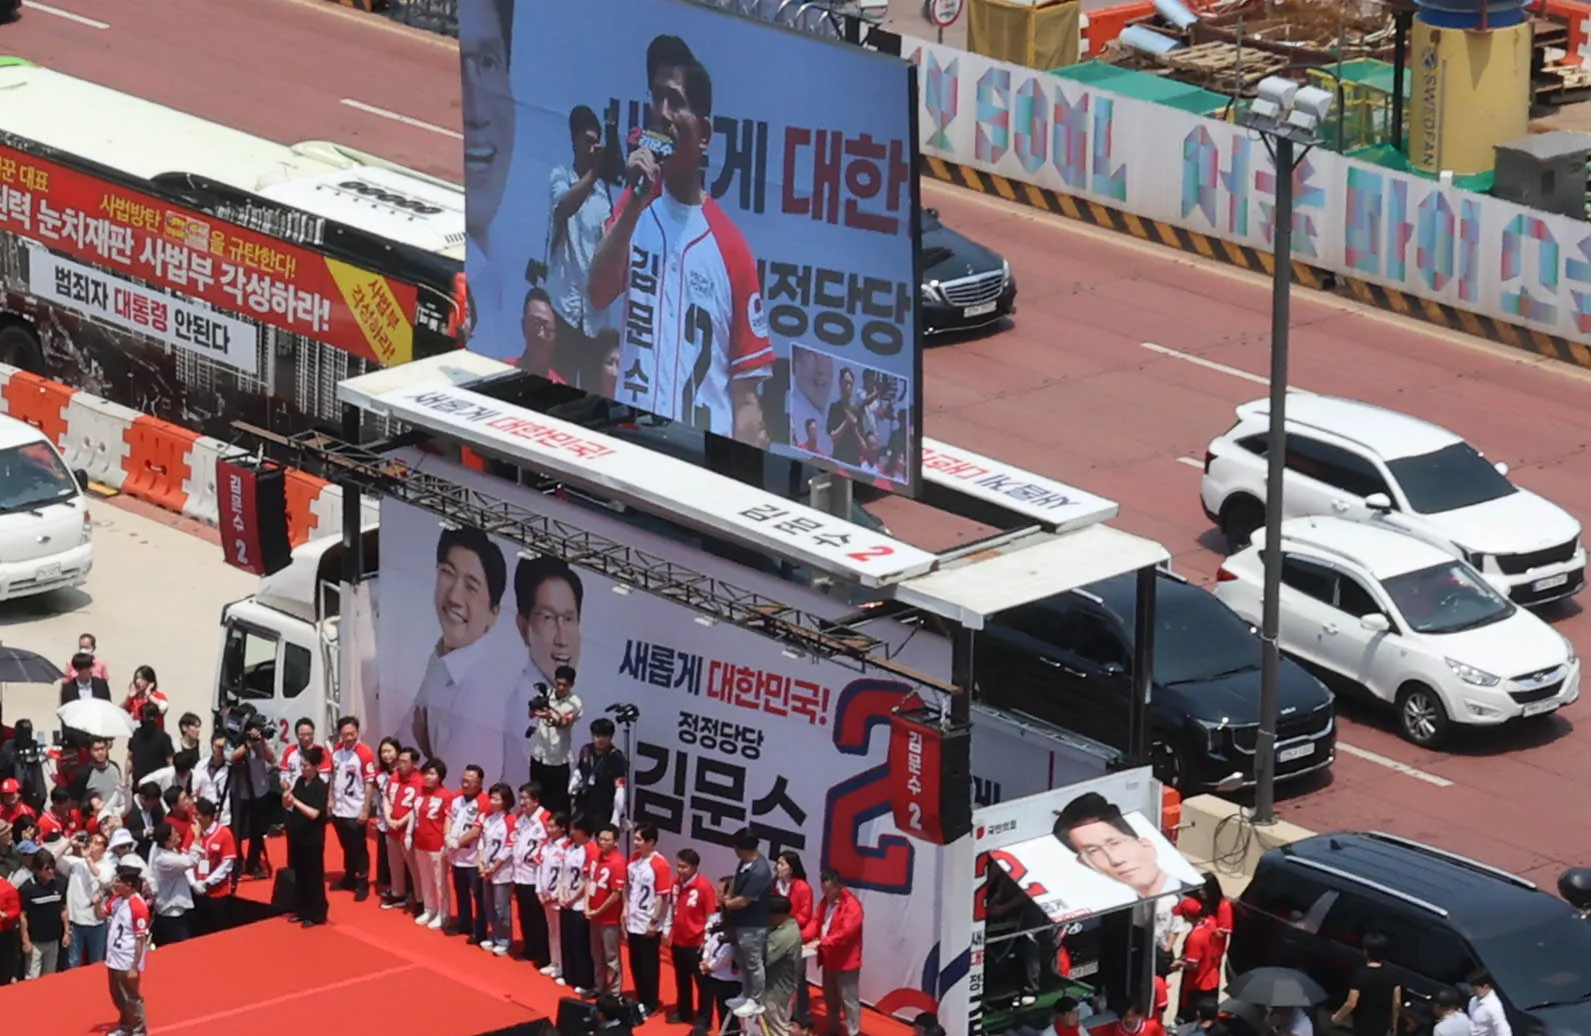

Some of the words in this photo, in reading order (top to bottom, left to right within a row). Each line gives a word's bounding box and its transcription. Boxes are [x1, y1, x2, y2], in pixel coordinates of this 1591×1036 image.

[975, 66, 1127, 203] SOUL
[19, 166, 49, 193] 대표
[37, 199, 134, 264] 눈치재판
[139, 236, 214, 291] 사법부
[220, 262, 330, 332] 각성하라!
[100, 194, 162, 233] 사법방탄
[229, 236, 296, 280] 규탄한다!
[55, 265, 108, 311] 범죄자
[113, 287, 169, 333] 대통령
[174, 308, 231, 354] 안된다
[623, 245, 661, 403] 김문수
[755, 258, 911, 356] 정당당
[236, 539, 248, 565] 2
[738, 503, 852, 547] 김문수
[845, 545, 895, 562] 2
[619, 638, 703, 697] 새롭게
[707, 659, 830, 726] 대한민국!
[678, 710, 764, 761] 정정당당
[907, 731, 922, 796] 김문수
[344, 772, 356, 796] 2
[401, 787, 416, 807] 2
[633, 742, 808, 862] 김문수
[821, 678, 927, 895] 2
[908, 802, 922, 831] 2
[599, 866, 611, 889] 2
[638, 885, 651, 909] 2
